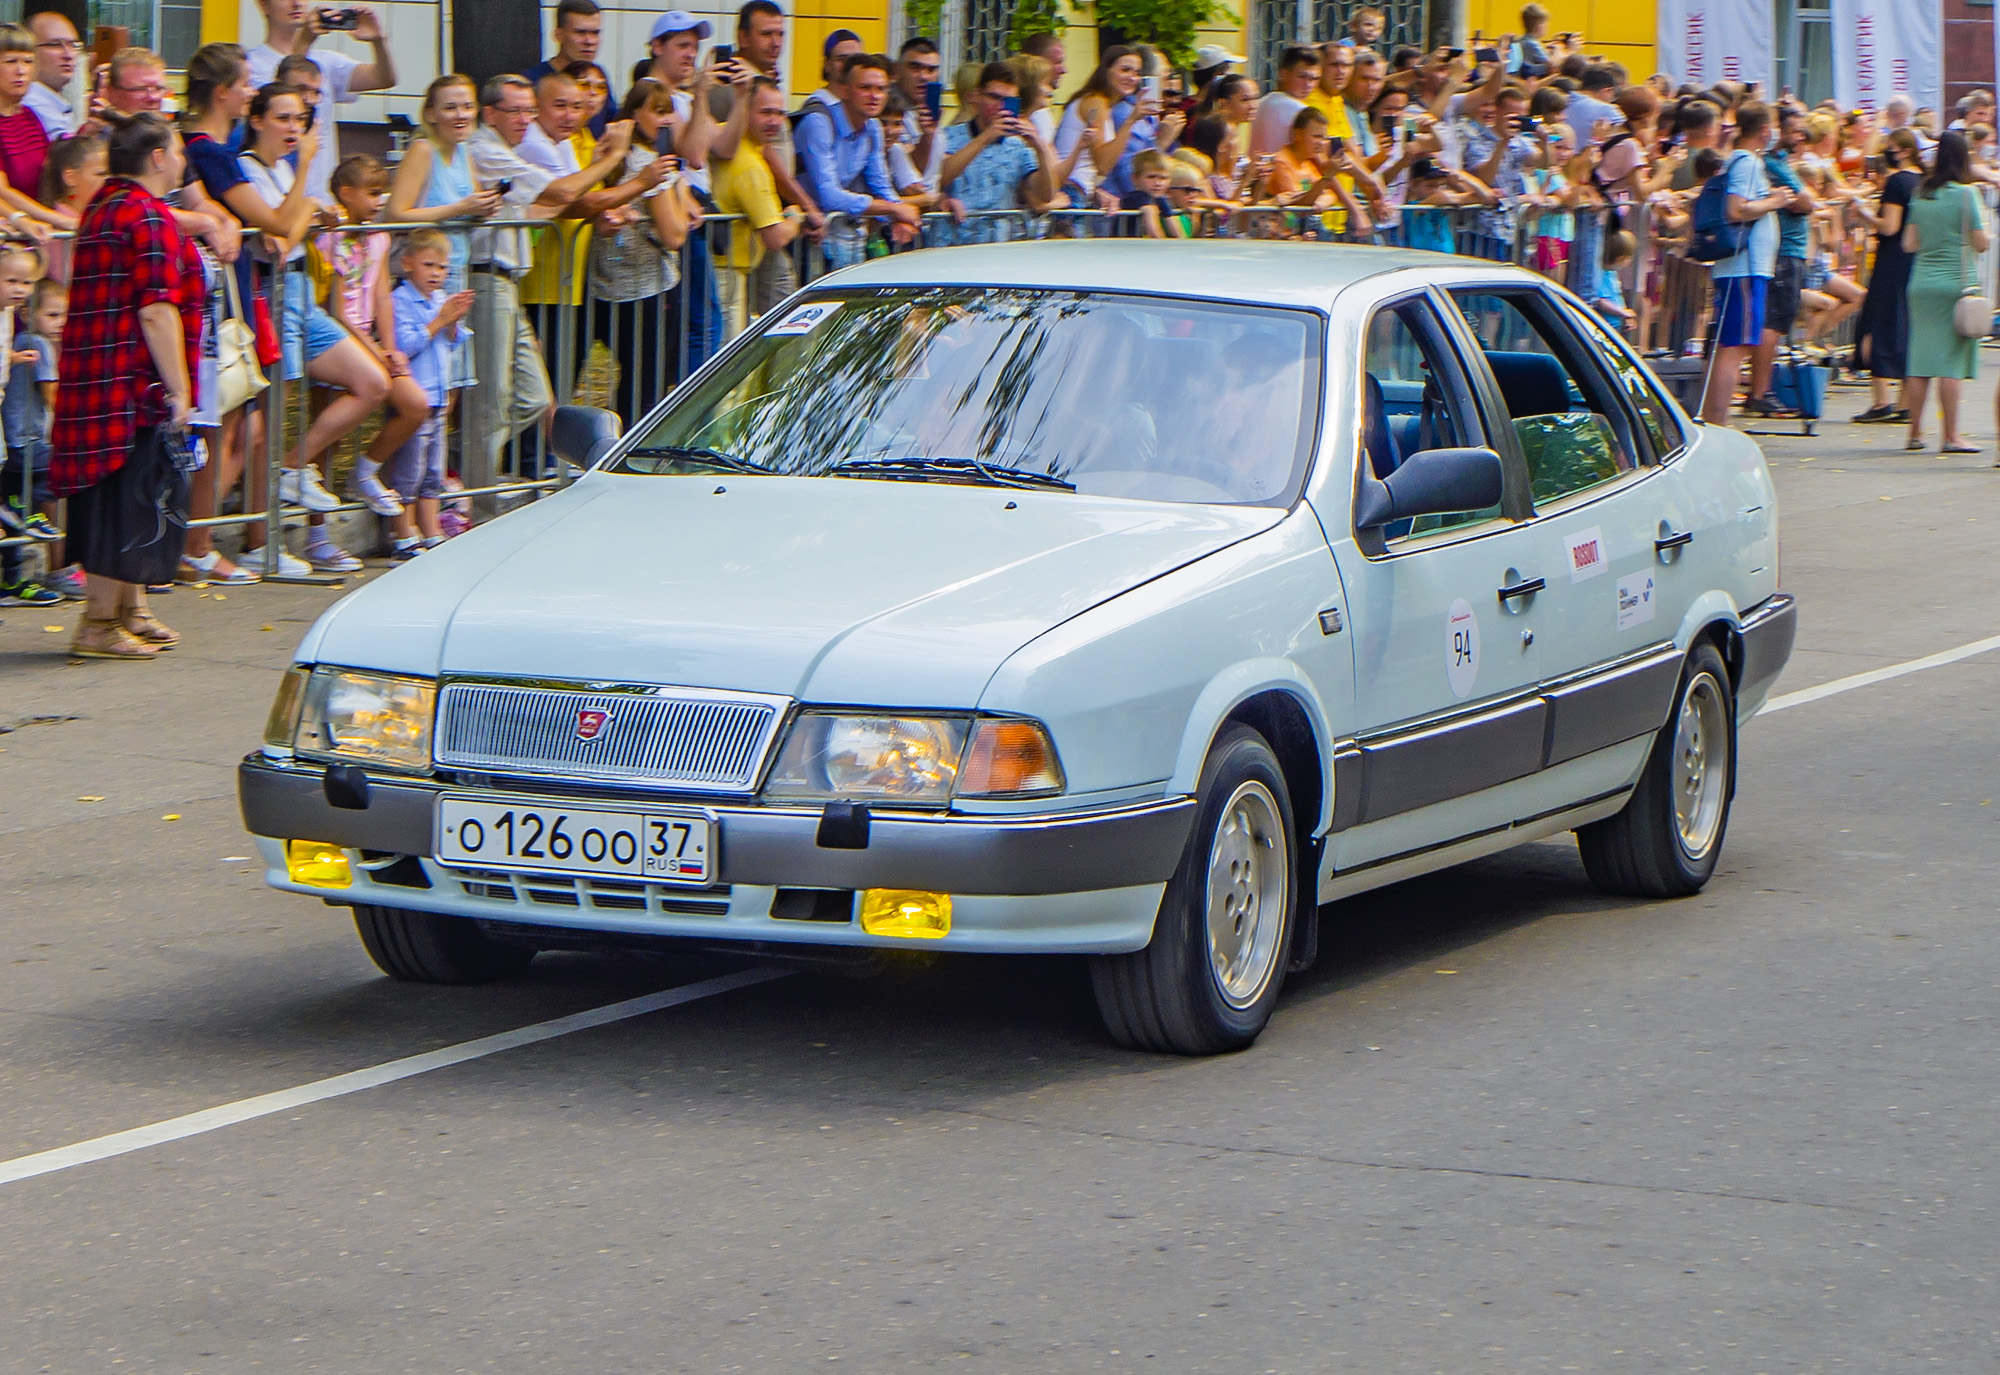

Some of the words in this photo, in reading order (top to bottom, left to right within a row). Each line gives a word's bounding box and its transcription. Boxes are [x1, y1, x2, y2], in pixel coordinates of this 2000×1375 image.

[1454, 629, 1472, 667] 94
[649, 821, 692, 858] 37
[646, 858, 678, 872] RUS
